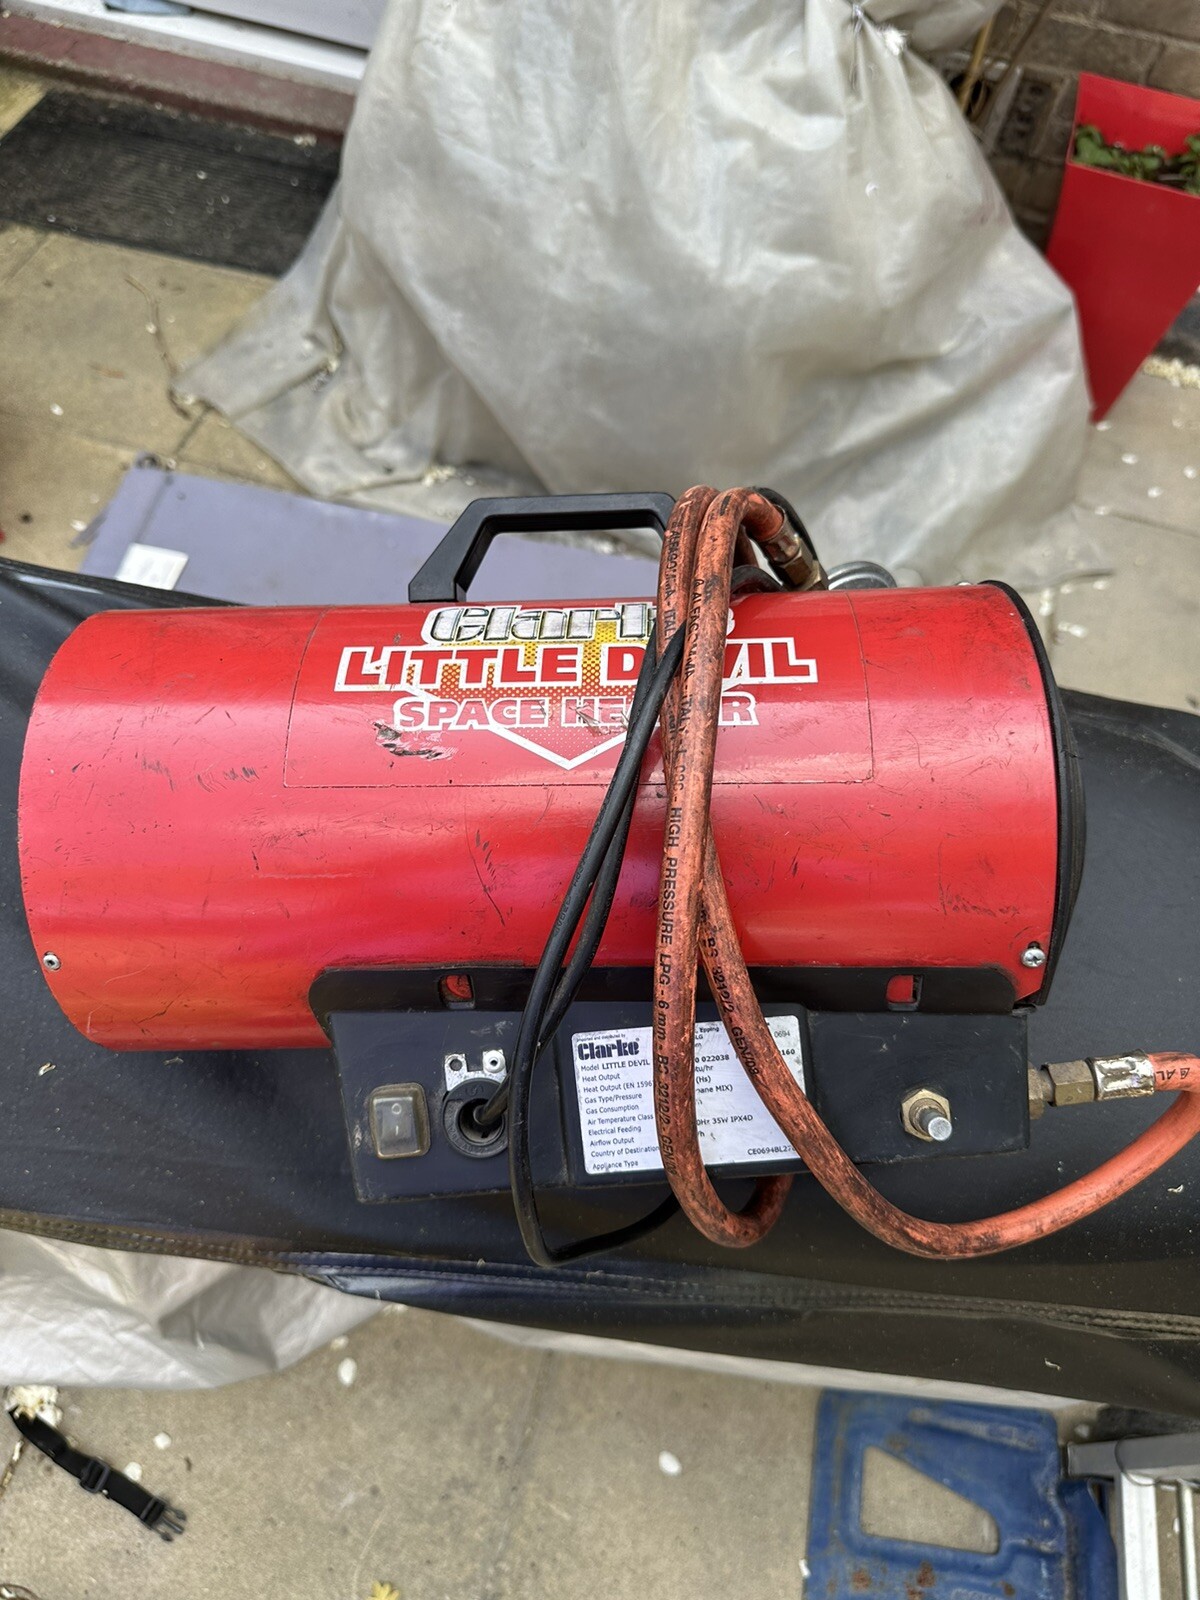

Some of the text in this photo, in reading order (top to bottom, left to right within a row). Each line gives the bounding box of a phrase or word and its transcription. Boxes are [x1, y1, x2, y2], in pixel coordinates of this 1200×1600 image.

[334, 643, 585, 692] LITTLE
[393, 696, 545, 731] SPACE
[667, 807, 682, 847] HIGH
[660, 856, 677, 945] PRESSURE
[658, 953, 672, 986] LPG
[658, 1001, 670, 1010] 6
[577, 1039, 640, 1061] Clarke
[580, 1063, 600, 1072] Model
[602, 1061, 626, 1070] LITTLE
[628, 1059, 651, 1067] DEVIL
[702, 1054, 730, 1062] 022038
[781, 1048, 796, 1056] 160
[598, 1073, 620, 1082] Output
[694, 1064, 714, 1073] tu/hr
[1153, 1068, 1176, 1082] AL
[600, 1083, 622, 1092] Output
[623, 1082, 635, 1090] (EN
[637, 1080, 654, 1089] 1596
[598, 1092, 643, 1104] Type/Pressure
[585, 1103, 640, 1115] Gas Consumption
[587, 1113, 654, 1126] Air Temperature Class
[588, 1127, 616, 1136] Electrical
[617, 1124, 642, 1133] Feeding
[730, 1114, 754, 1123] IPX4D
[589, 1136, 635, 1147] Airflow Output
[590, 1148, 616, 1158] Country
[617, 1147, 624, 1156] of
